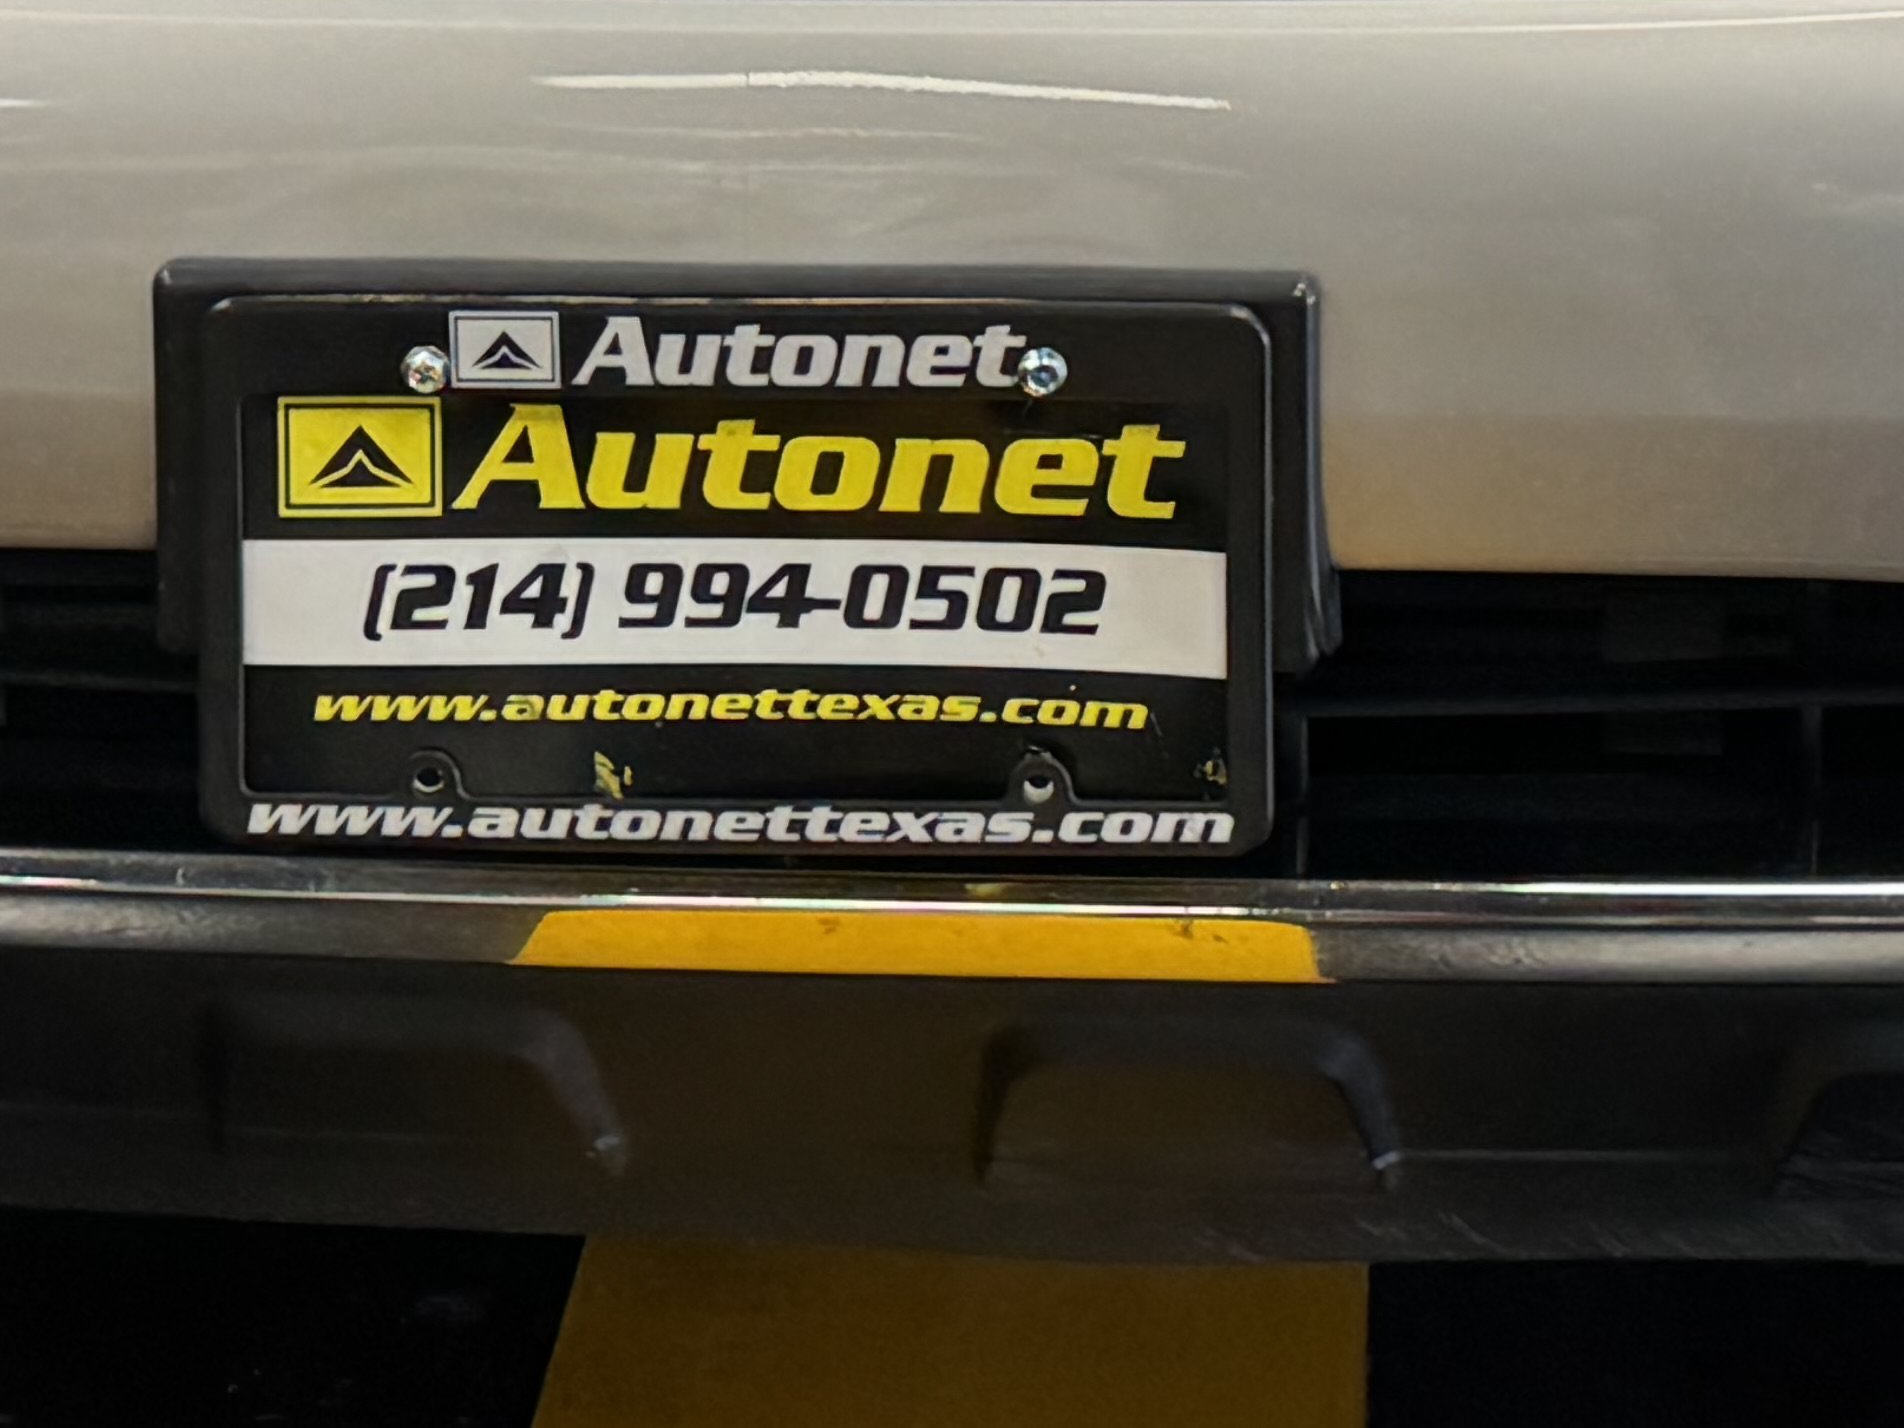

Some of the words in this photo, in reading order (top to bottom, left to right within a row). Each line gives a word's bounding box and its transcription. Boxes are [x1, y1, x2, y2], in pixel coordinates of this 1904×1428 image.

[573, 315, 1026, 389] Autonet
[451, 404, 1186, 519] Autonet
[364, 562, 594, 640] (214)
[618, 562, 1107, 636] 994-0502
[313, 688, 1149, 730] www.autonettexas.com
[247, 800, 1234, 845] www.autonettexas.com
